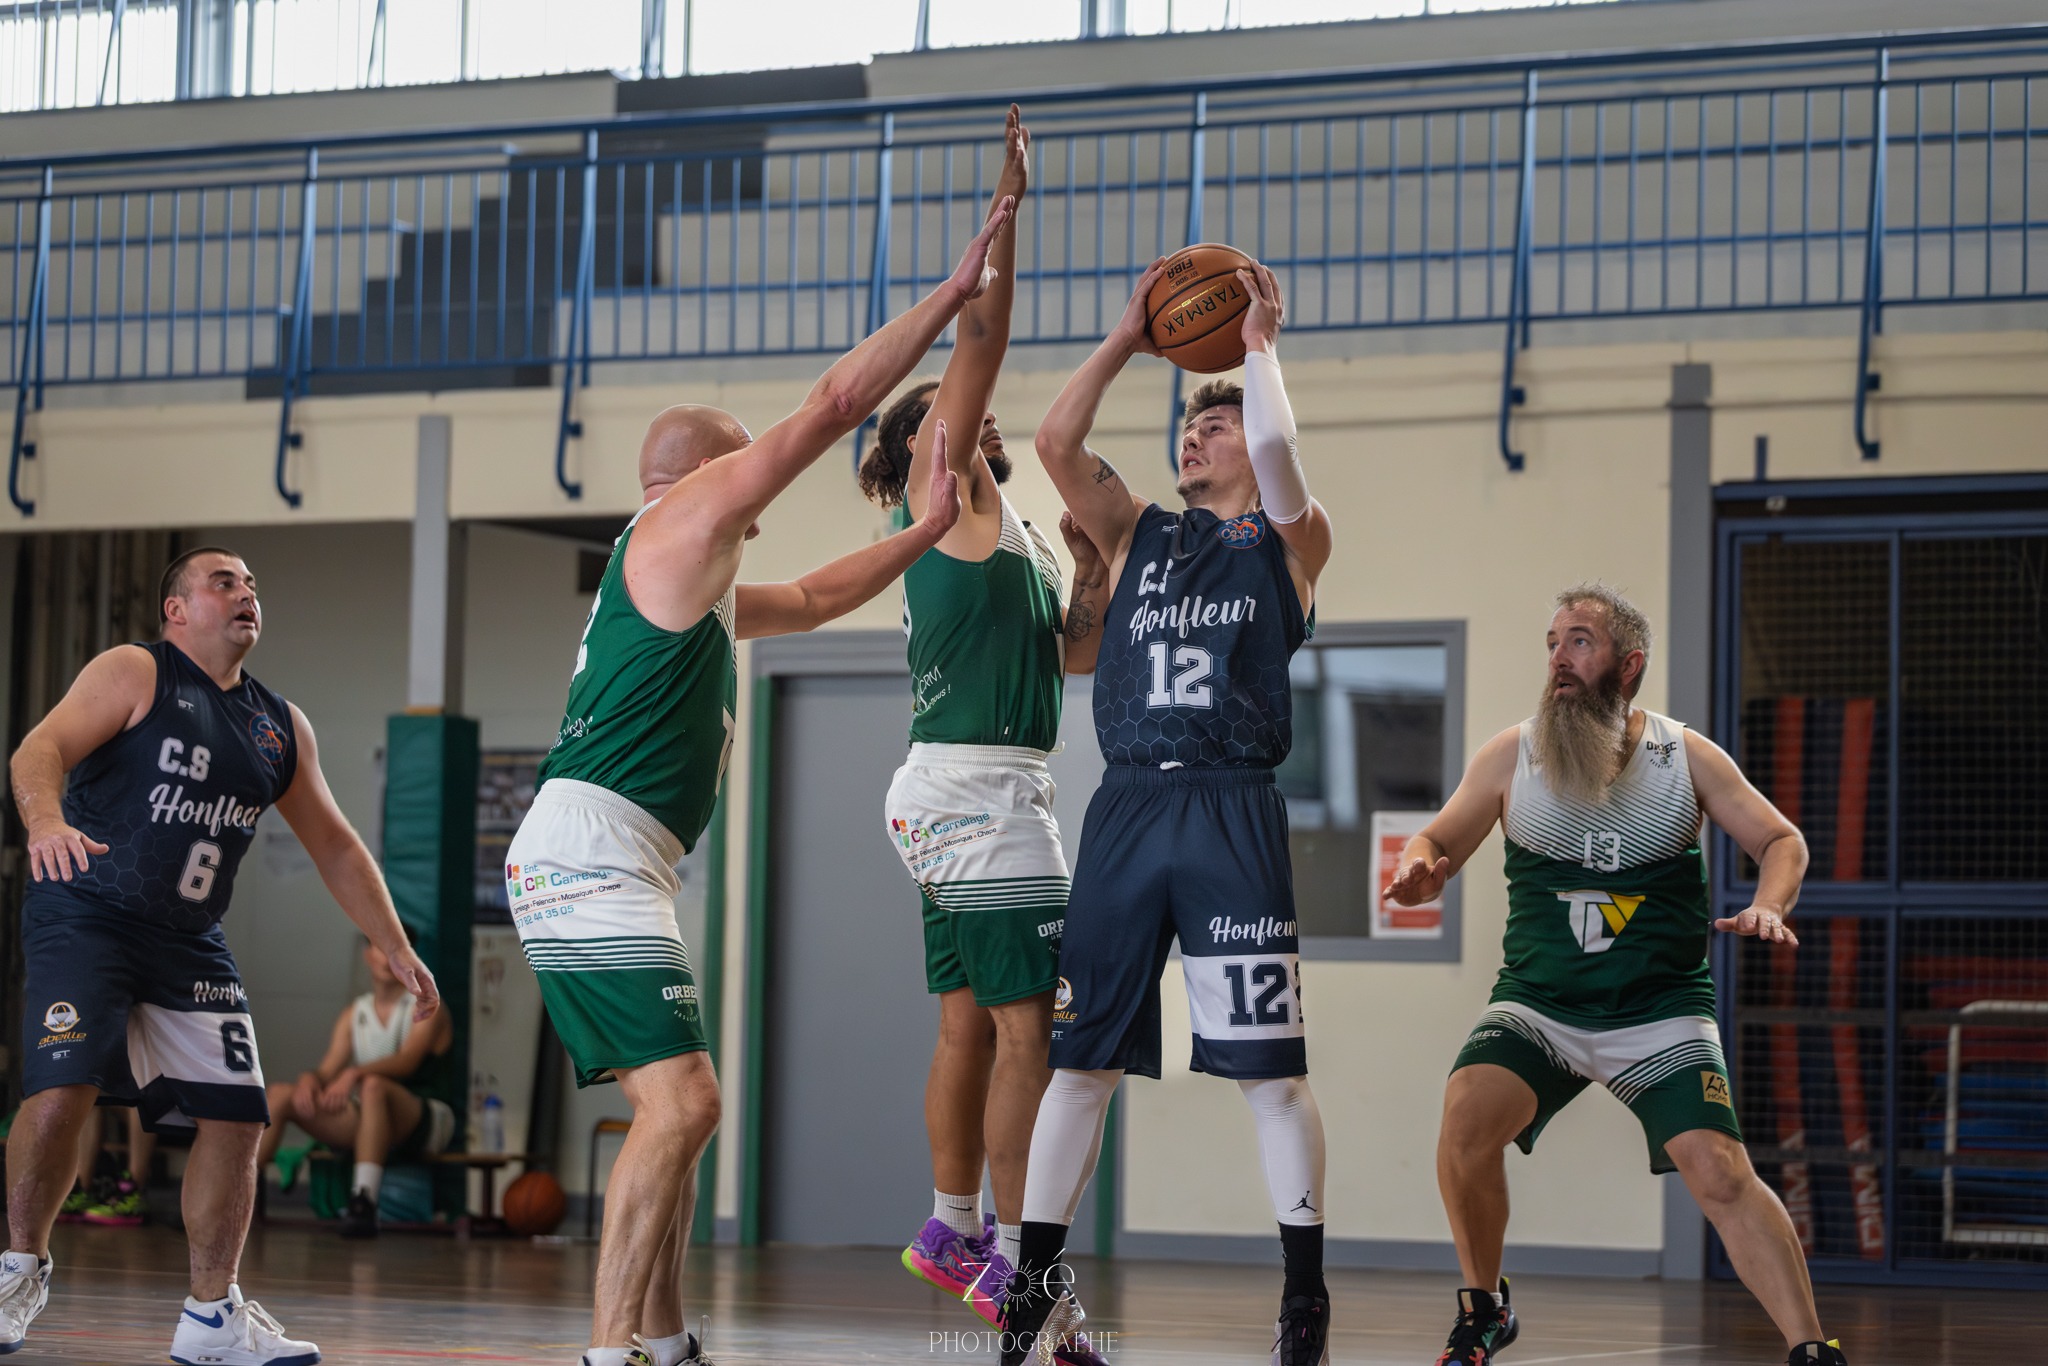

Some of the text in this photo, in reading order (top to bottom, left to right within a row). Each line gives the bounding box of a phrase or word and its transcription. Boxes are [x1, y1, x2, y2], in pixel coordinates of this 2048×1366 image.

[1167, 258, 1194, 279] FIBA
[1162, 284, 1241, 336] TARMAK
[1129, 595, 1257, 646] Honfleur
[1147, 641, 1213, 709] 12
[158, 737, 211, 782] C.S
[911, 812, 991, 843] CR Carrelage
[977, 827, 997, 838] Chape
[932, 855, 944, 866] 35
[945, 850, 956, 861] 05
[1582, 830, 1622, 872] 13
[177, 839, 223, 904] 6
[525, 875, 546, 892] CR
[598, 883, 622, 893] Chape
[523, 915, 533, 925] 82
[533, 911, 543, 921] 44
[545, 908, 559, 918] 35
[560, 904, 575, 915] 05
[193, 981, 248, 1006] Honfle
[662, 985, 697, 1000] ORBE
[1223, 962, 1290, 1027] 12
[1053, 1010, 1078, 1020] eille
[39, 1031, 87, 1046] abeille
[220, 1021, 254, 1073] 6
[52, 1050, 71, 1060] ST
